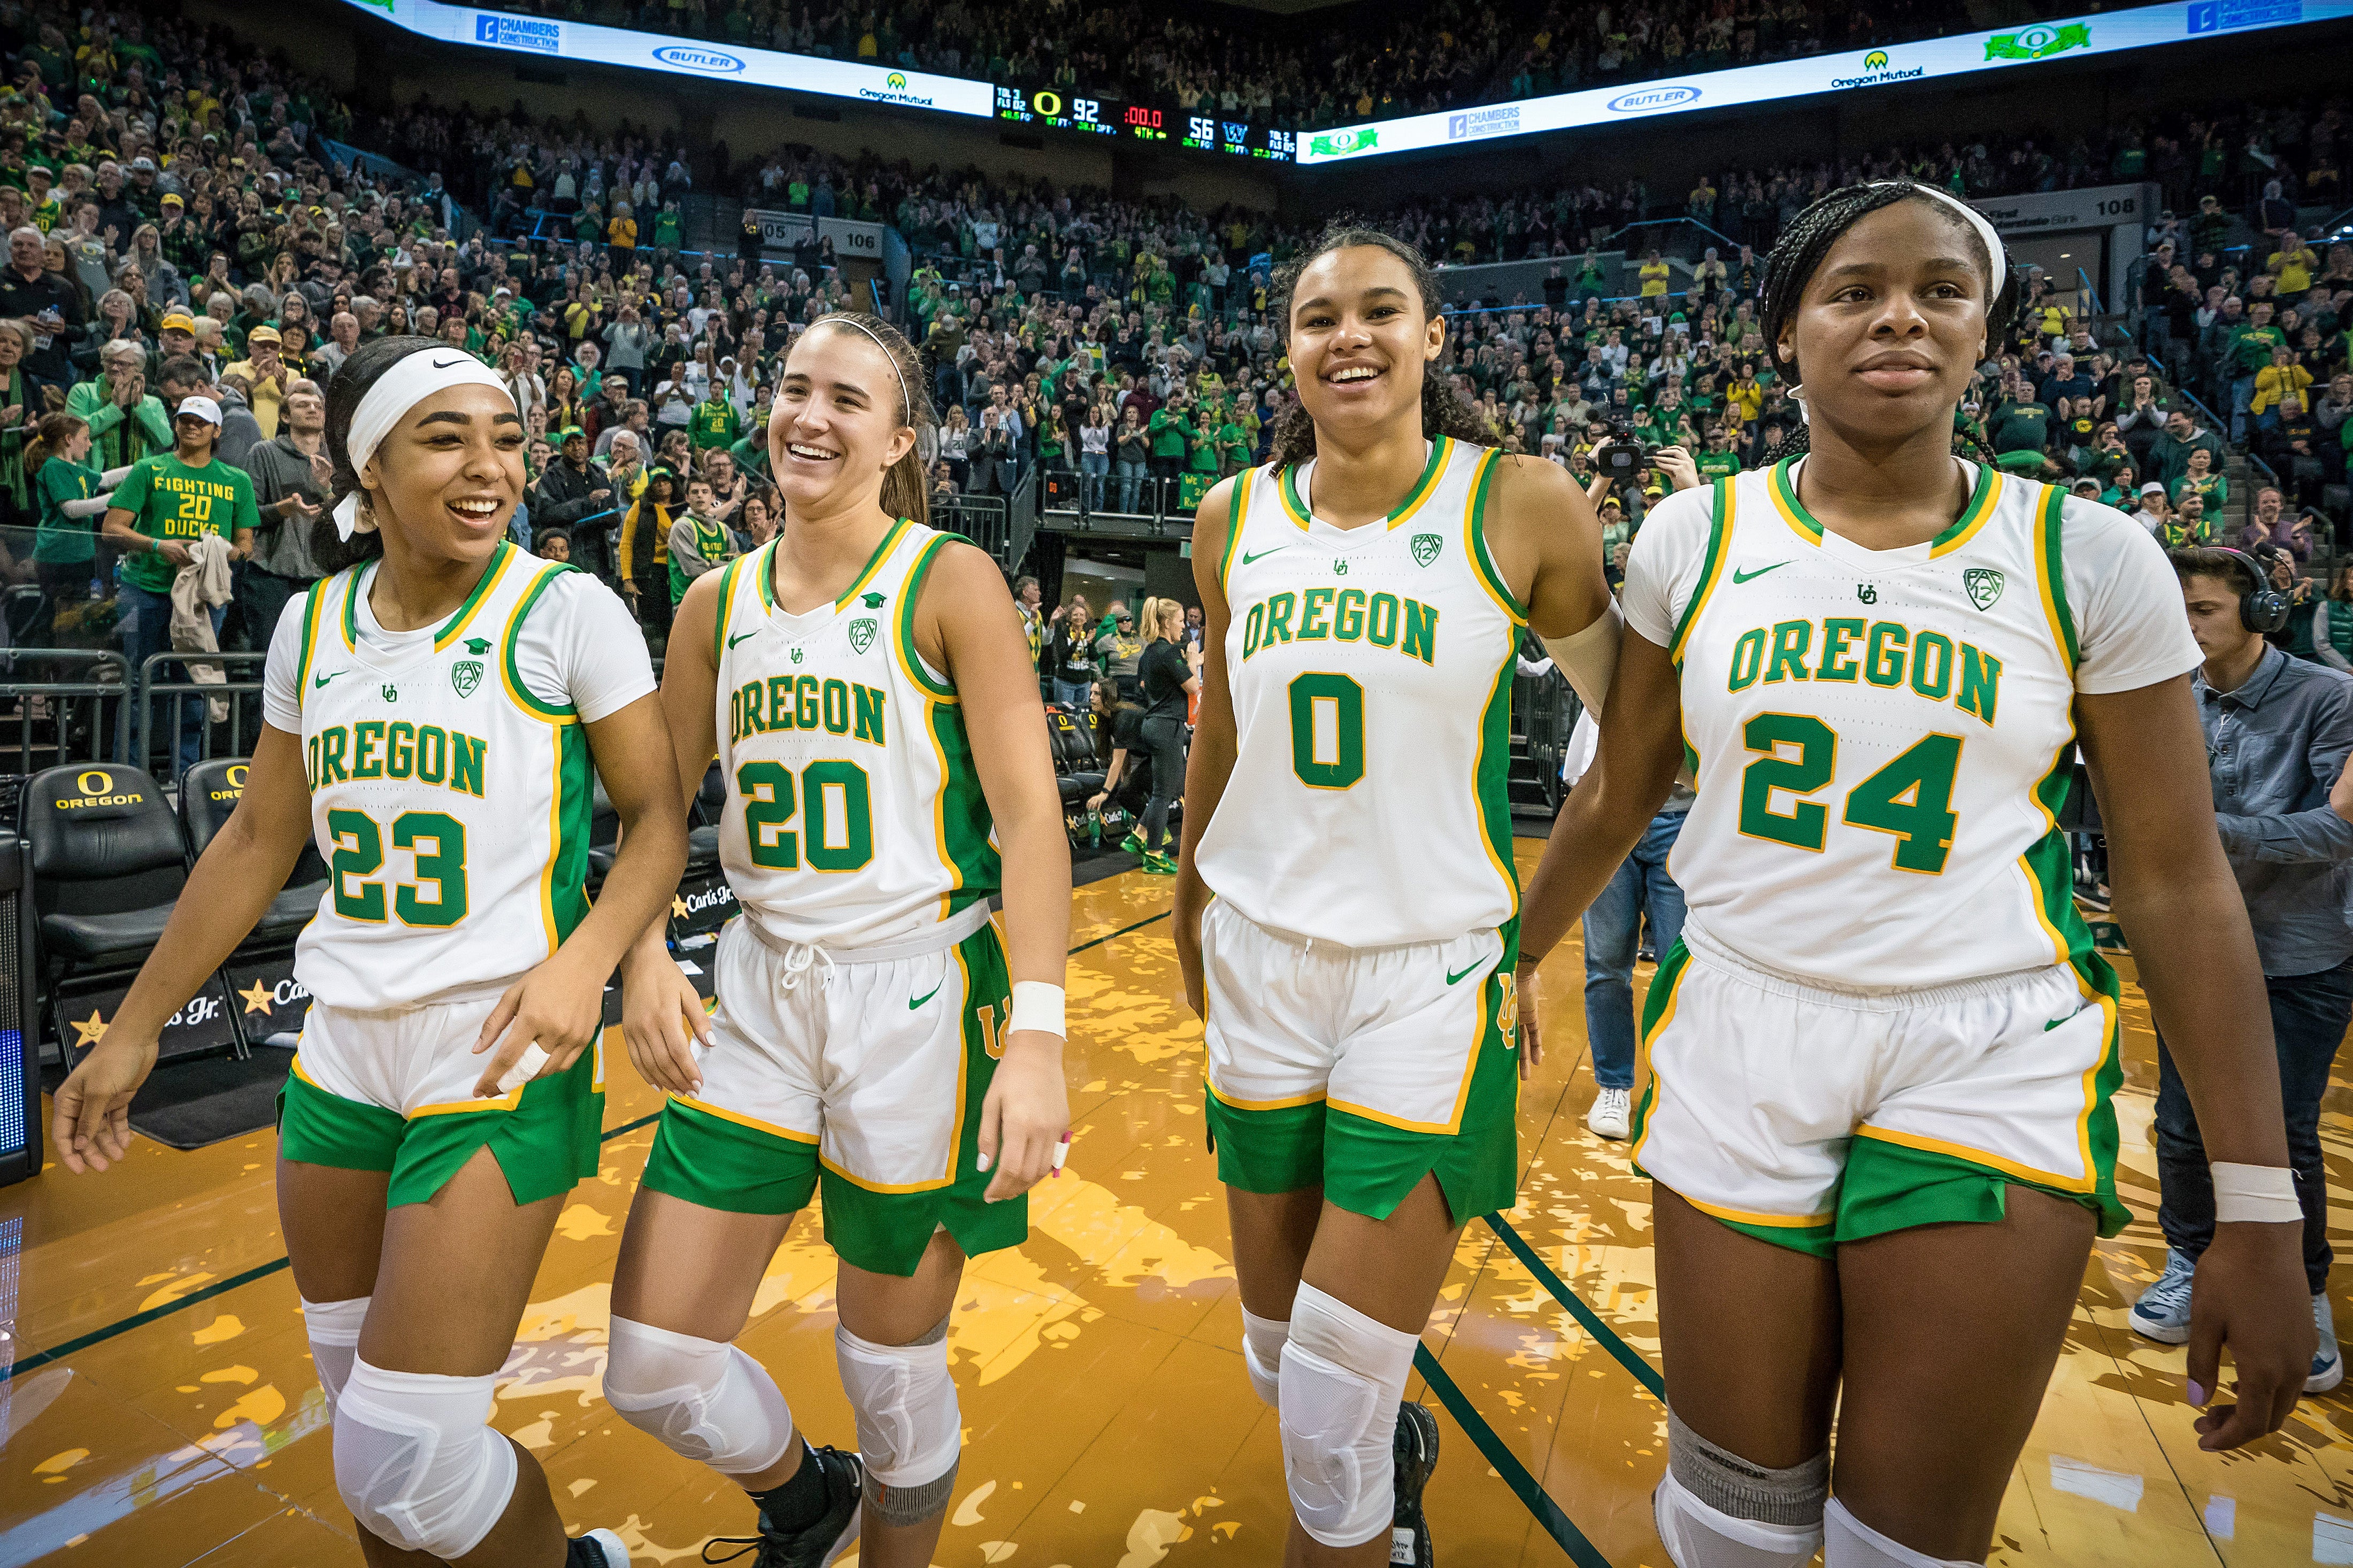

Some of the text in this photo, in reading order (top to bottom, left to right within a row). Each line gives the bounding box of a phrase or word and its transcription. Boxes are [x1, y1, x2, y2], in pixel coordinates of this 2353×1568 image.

[500, 18, 559, 37] CHAMBERS
[670, 51, 730, 67] BUTLER
[1832, 66, 1923, 87] Oregon Mutual
[859, 88, 933, 105] Oregon Mutual
[1034, 91, 1061, 115] O
[1624, 91, 1686, 106] BUTLER
[1073, 98, 1099, 123] 92
[1469, 106, 1520, 124] CHAMBERS
[1134, 126, 1154, 140] 4TH
[1190, 117, 1214, 141] 56
[1222, 122, 1248, 144] W
[1283, 132, 1290, 142] 2
[2097, 198, 2135, 215] 108
[765, 225, 786, 238] 05
[848, 233, 875, 249] 106
[155, 476, 234, 501] FIGHTING
[179, 493, 212, 521] 20
[165, 518, 220, 537] DUCKS
[1413, 535, 1442, 552] PAC
[1417, 547, 1433, 560] 12
[1966, 569, 2004, 591] PAC
[1974, 586, 1994, 602] 12
[850, 619, 876, 636] PAC
[1242, 587, 1440, 667] OREGON
[854, 634, 869, 646] 12
[455, 662, 483, 681] PAC
[1727, 616, 2003, 728] OREGON
[457, 676, 473, 690] 12
[731, 674, 887, 748] OREGON
[308, 720, 488, 799] OREGON
[77, 771, 114, 795] O
[56, 793, 143, 809] OREGON
[210, 789, 243, 801] ORE
[1737, 711, 1965, 876] 24
[736, 758, 875, 874] 20
[327, 807, 470, 929] 23
[687, 885, 734, 913] Carl's Jr.
[187, 997, 219, 1025] Jr.
